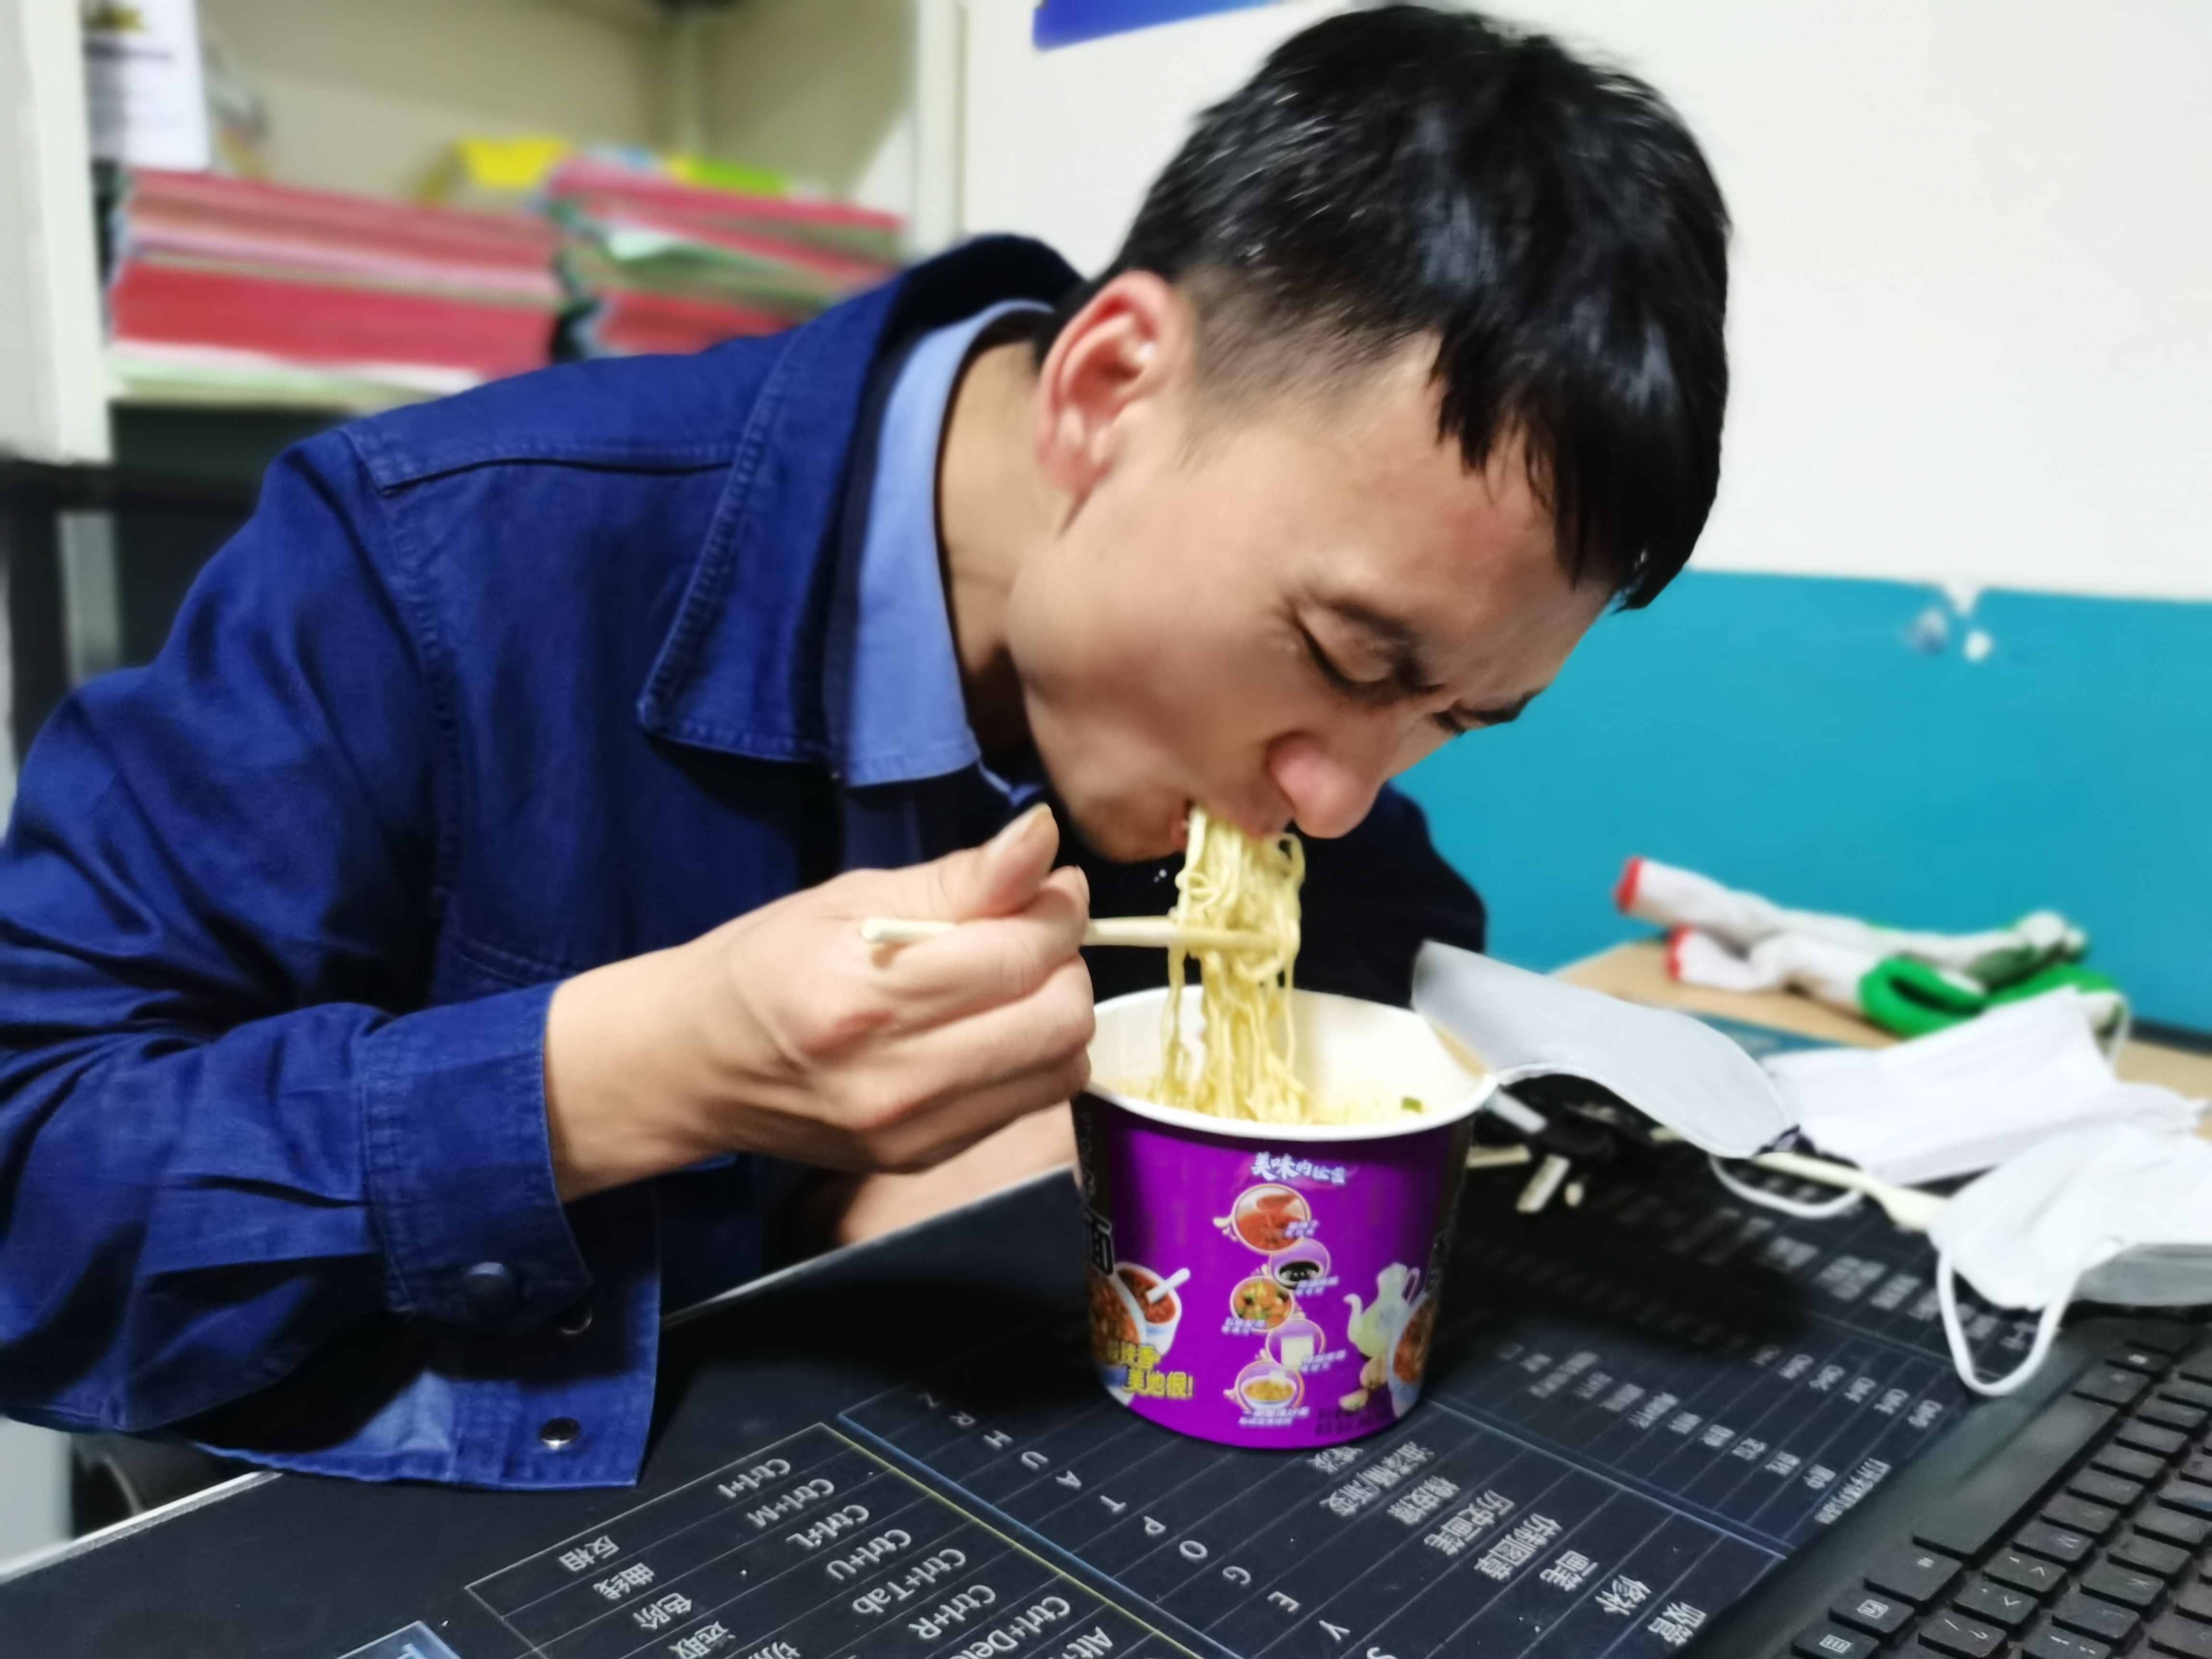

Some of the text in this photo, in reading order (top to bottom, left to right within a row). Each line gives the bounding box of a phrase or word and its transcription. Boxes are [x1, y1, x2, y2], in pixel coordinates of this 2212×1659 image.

[984, 1431, 1012, 1448] H
[718, 1459, 791, 1498] Ctrl+I
[1021, 1451, 1048, 1469] U
[1056, 1470, 1082, 1489] A
[746, 1479, 834, 1528] Ctrl+M
[1100, 1496, 1126, 1513] T
[1424, 1489, 1515, 1555] 历史画笔
[786, 1505, 870, 1549] Ctrl+L
[1144, 1516, 1166, 1535] P
[559, 1535, 619, 1572] 反相
[827, 1529, 912, 1580] Ctrl+U
[1474, 1513, 1563, 1581] 仿制图章
[593, 1562, 655, 1599] 曲线
[853, 1549, 966, 1614] Ctrl+Tab
[1223, 1566, 1251, 1585] G
[1540, 1551, 1598, 1592] 画笔
[633, 1592, 692, 1630] 色阶
[908, 1585, 996, 1640] Ctrl+R
[1268, 1591, 1300, 1613] E
[1596, 1575, 1652, 1616] 修补
[1319, 1620, 1350, 1641] Y
[1648, 1602, 1707, 1646] 吸管
